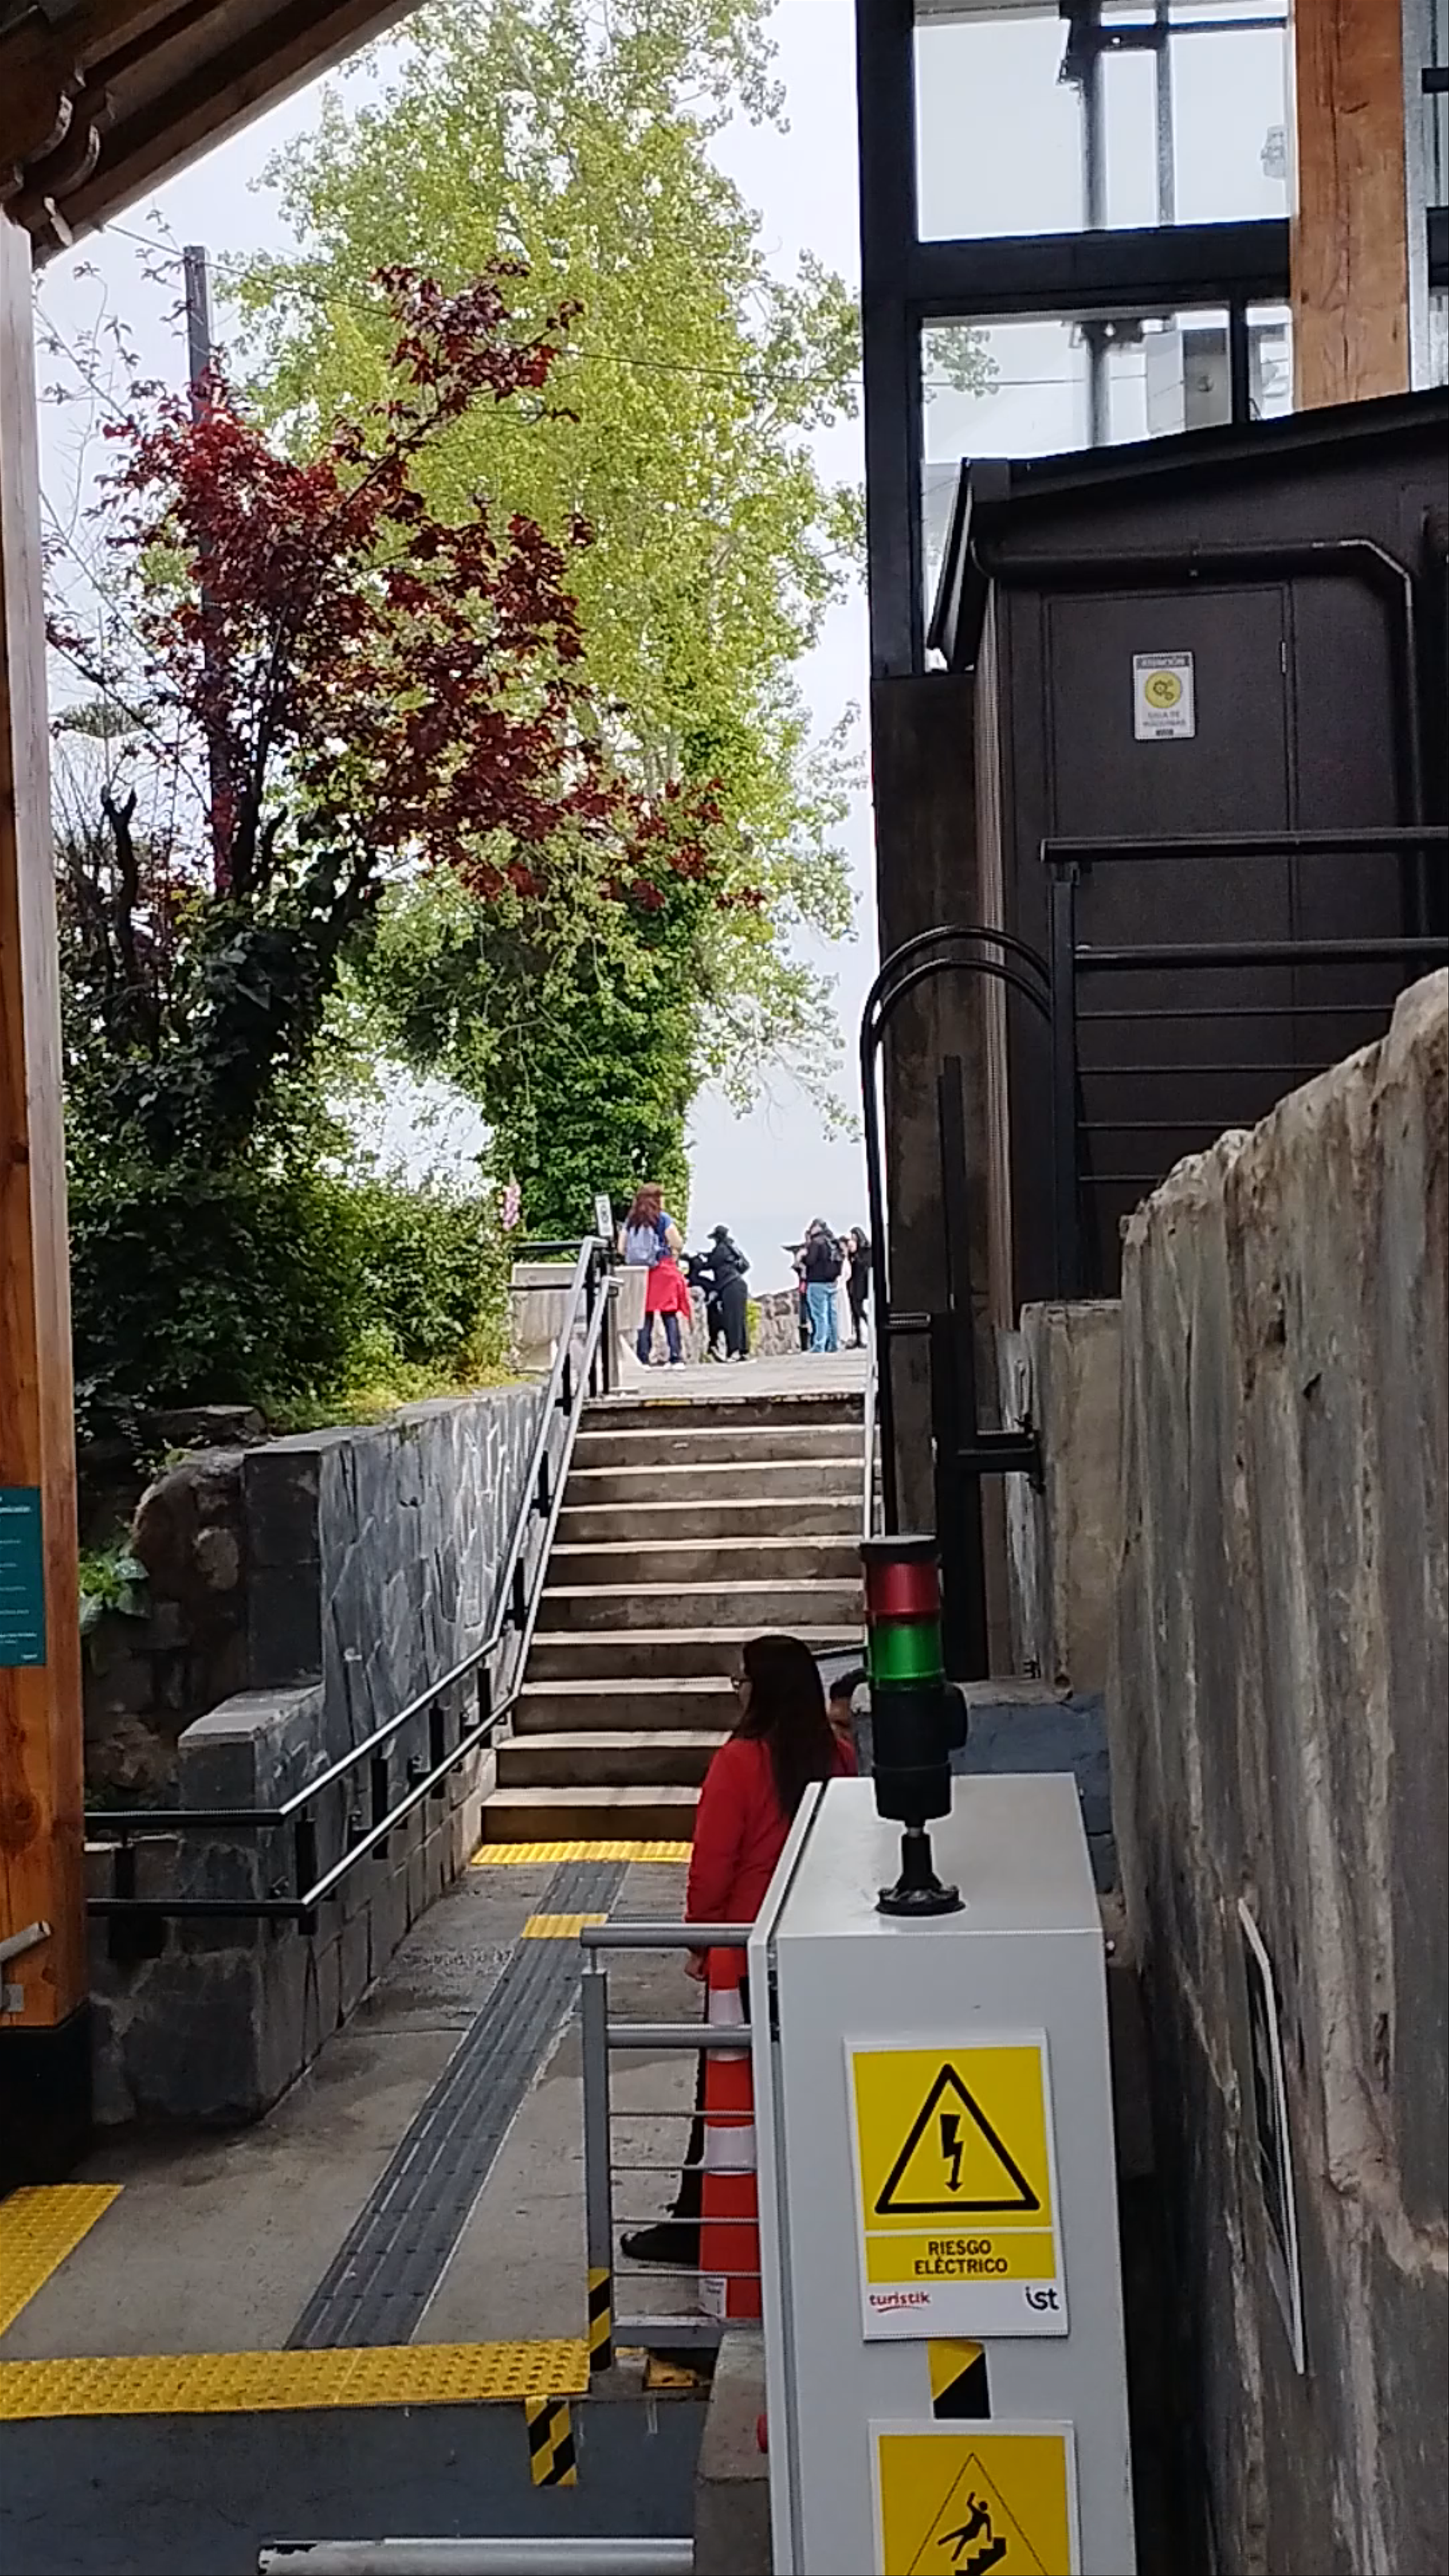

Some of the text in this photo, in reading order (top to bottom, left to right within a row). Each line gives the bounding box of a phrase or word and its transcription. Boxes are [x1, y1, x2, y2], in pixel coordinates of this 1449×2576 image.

[928, 2240, 992, 2256] RIESGO
[915, 2256, 1008, 2275] ELÉCTRICO
[869, 2291, 931, 2306] turistik
